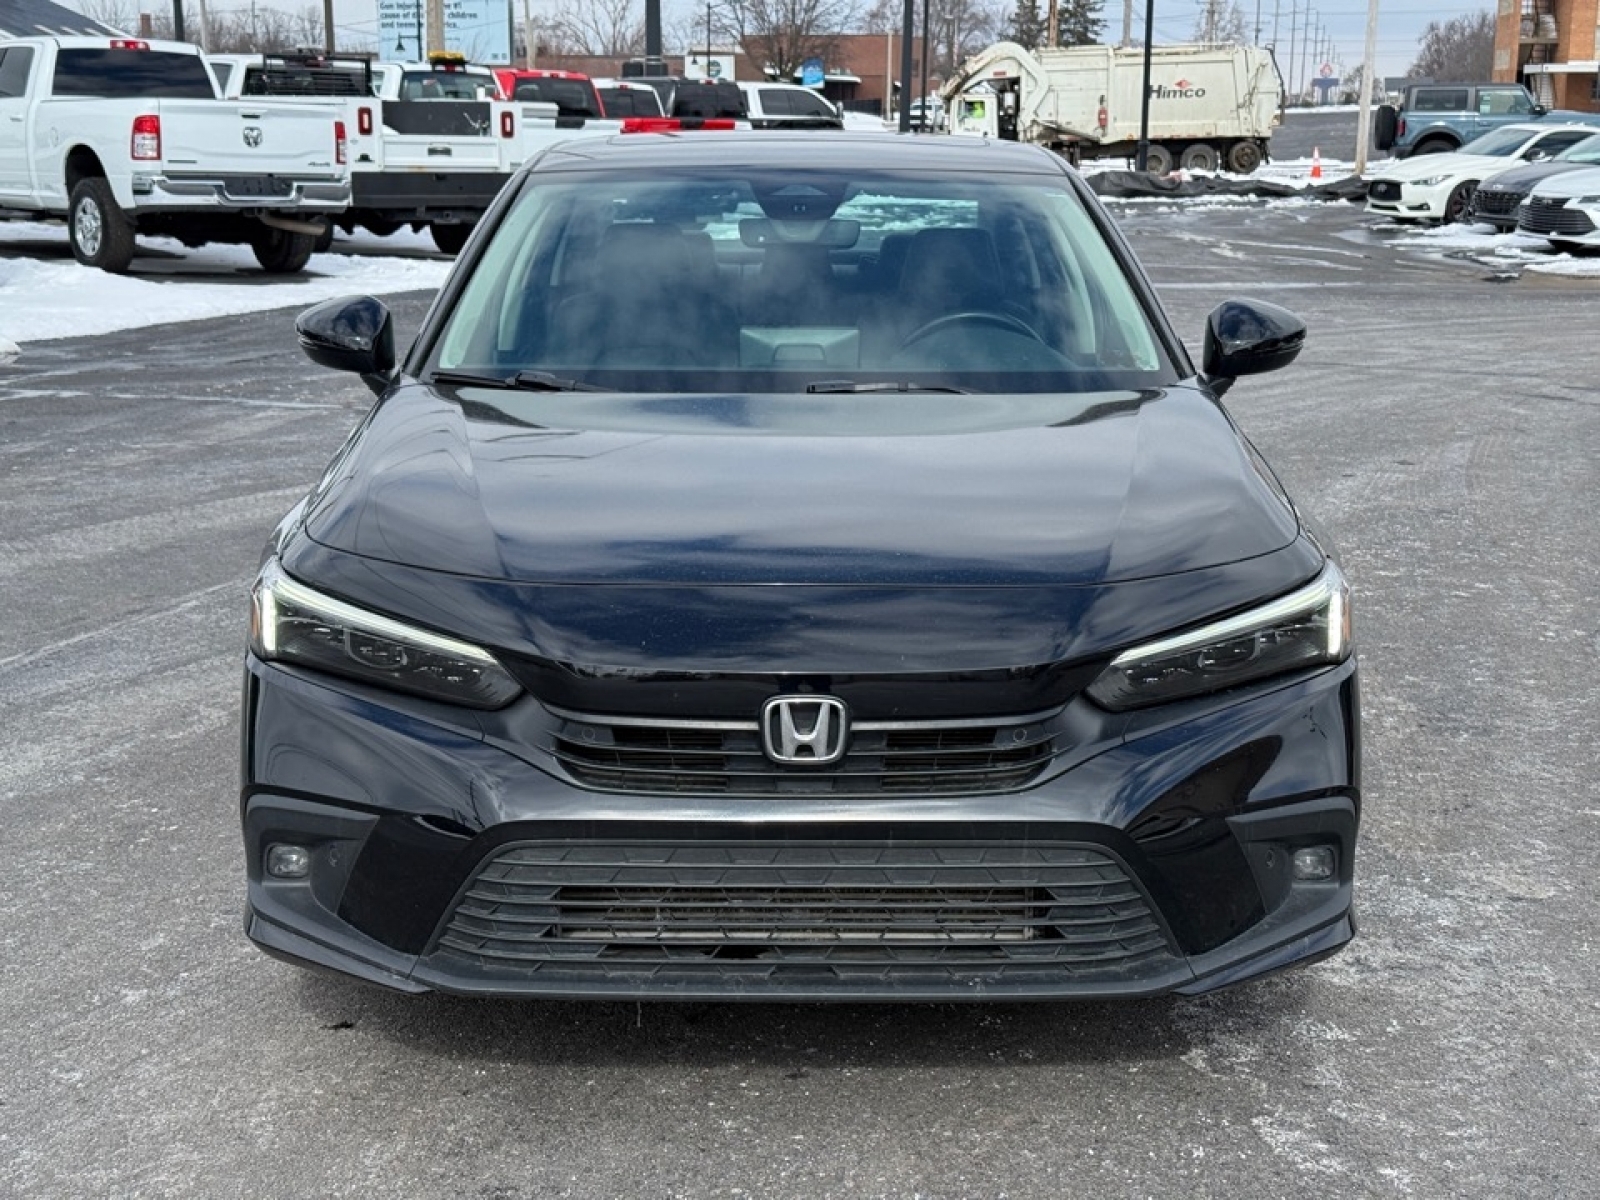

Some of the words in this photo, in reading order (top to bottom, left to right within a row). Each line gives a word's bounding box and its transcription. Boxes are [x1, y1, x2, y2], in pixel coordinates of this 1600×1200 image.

[380, 2, 394, 10] Gun
[447, 11, 478, 19] children
[1148, 84, 1206, 99] Himco
